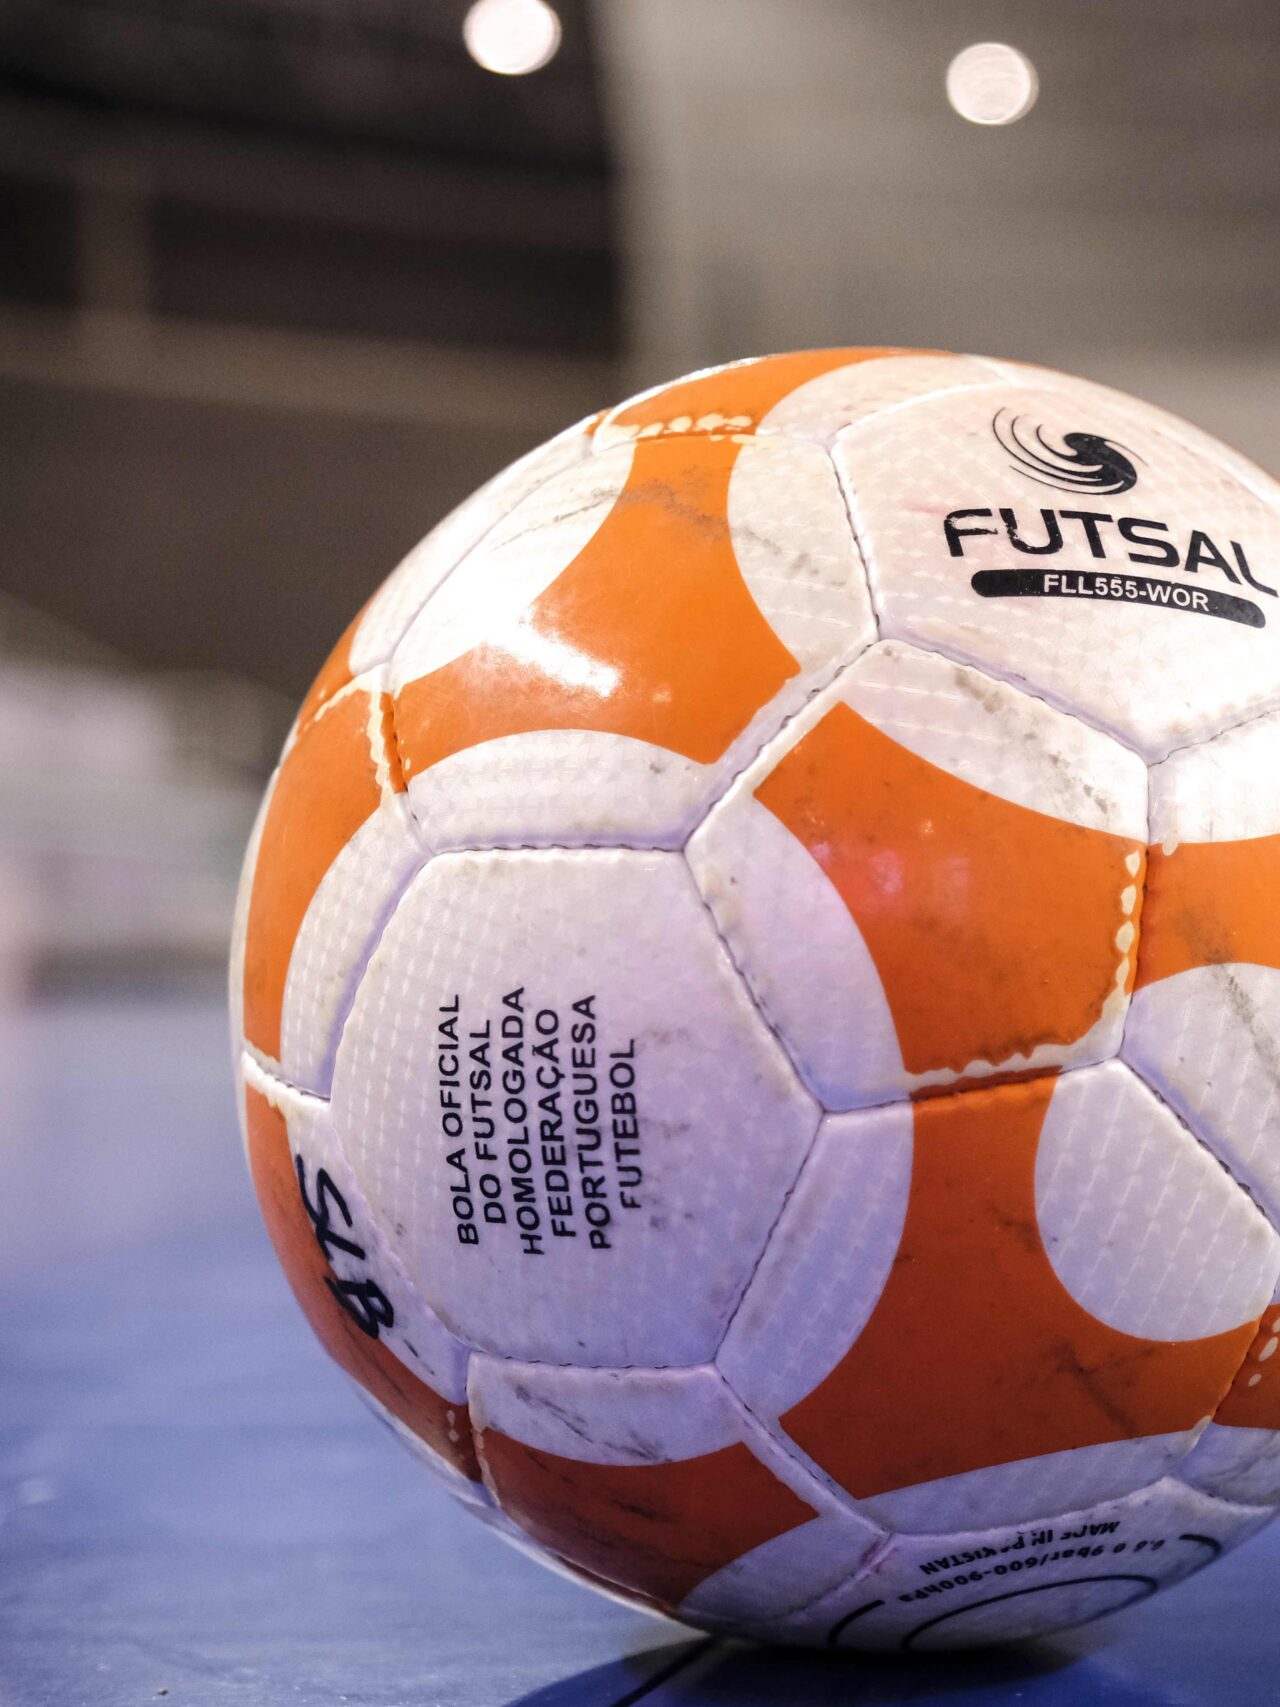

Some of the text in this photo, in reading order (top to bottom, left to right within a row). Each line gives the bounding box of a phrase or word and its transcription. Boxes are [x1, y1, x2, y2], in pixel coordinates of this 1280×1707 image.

[944, 508, 1279, 598] FUTSAL
[1043, 574, 1210, 612] FLL555-WOR
[438, 994, 479, 1245] BOLA OFICIAL
[469, 1019, 507, 1224] DO FUTSAL
[502, 986, 545, 1255] HOMOLOGADA
[532, 1009, 576, 1237] FEDERAÇÃO
[571, 995, 612, 1249] PORTUGUESA
[609, 1038, 642, 1209] FUTEBOL
